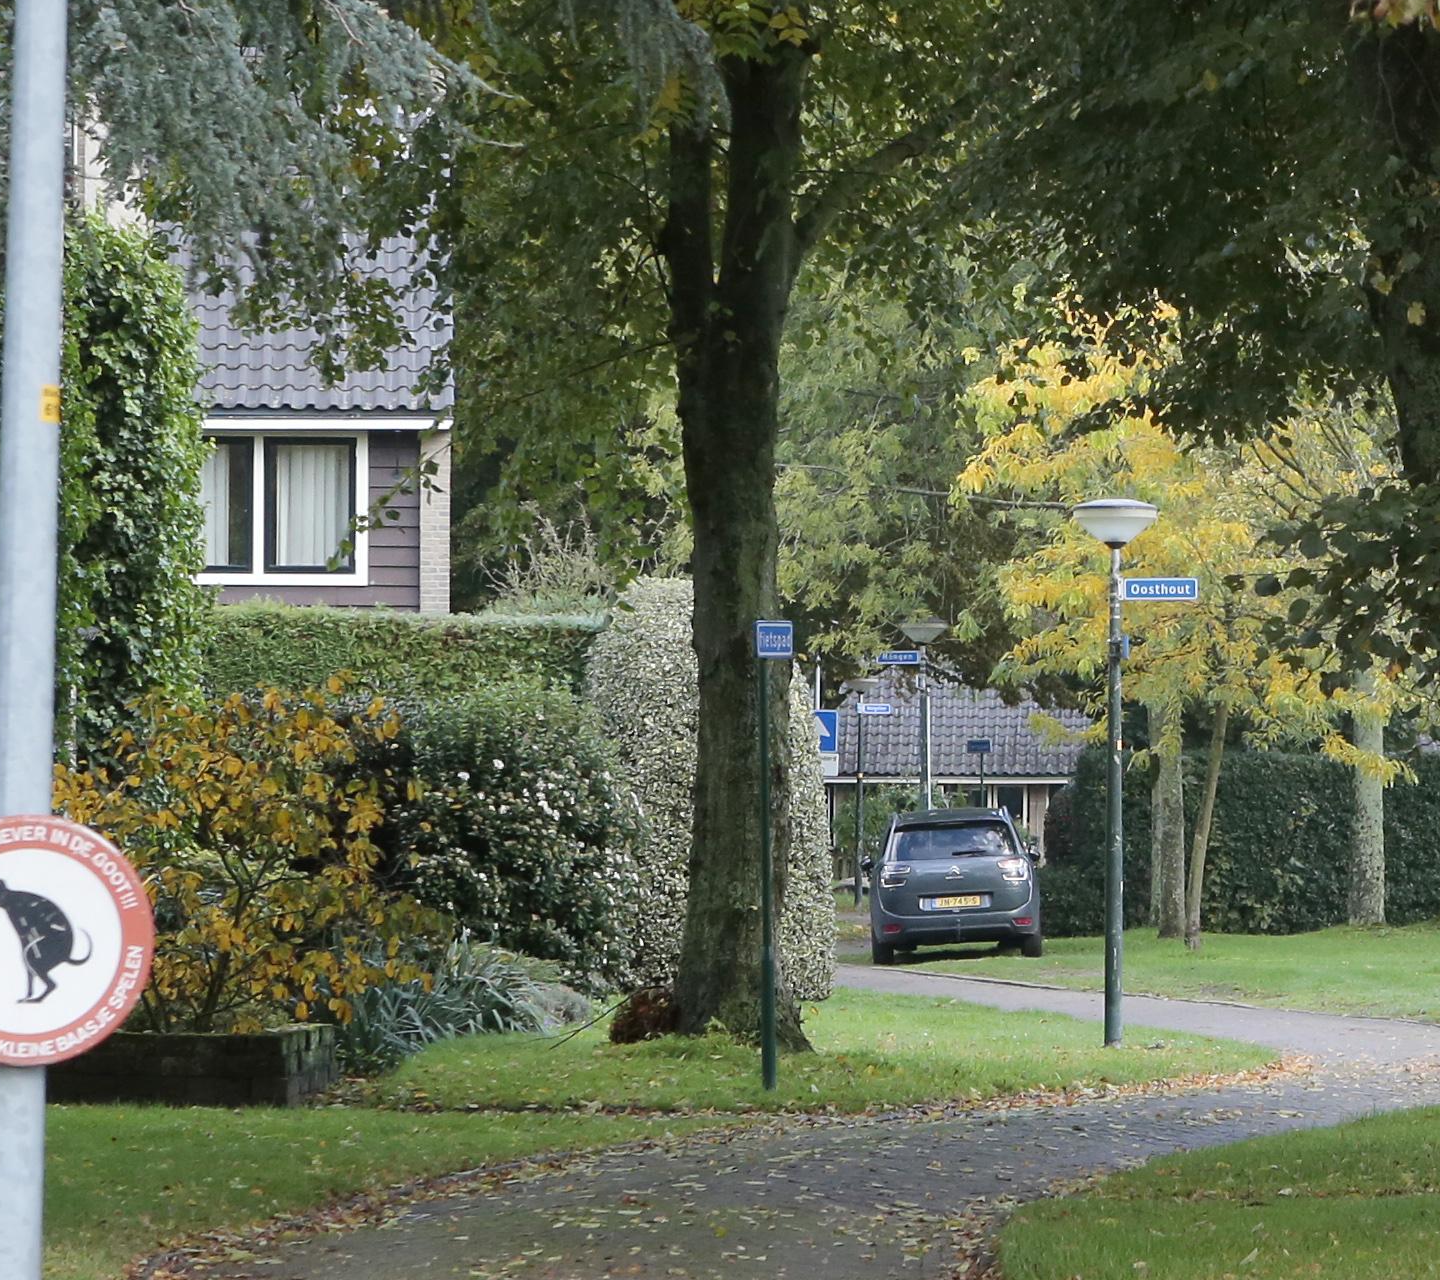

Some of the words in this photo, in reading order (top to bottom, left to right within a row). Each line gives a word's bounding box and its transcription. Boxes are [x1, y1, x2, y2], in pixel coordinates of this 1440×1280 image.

[1130, 583, 1191, 595] Oosthout
[49, 828, 71, 847] IN
[68, 835, 96, 858] DE
[92, 853, 139, 910] GOOT!!!
[56, 1006, 116, 1052] BAASJE
[108, 945, 145, 1009] SPELEN
